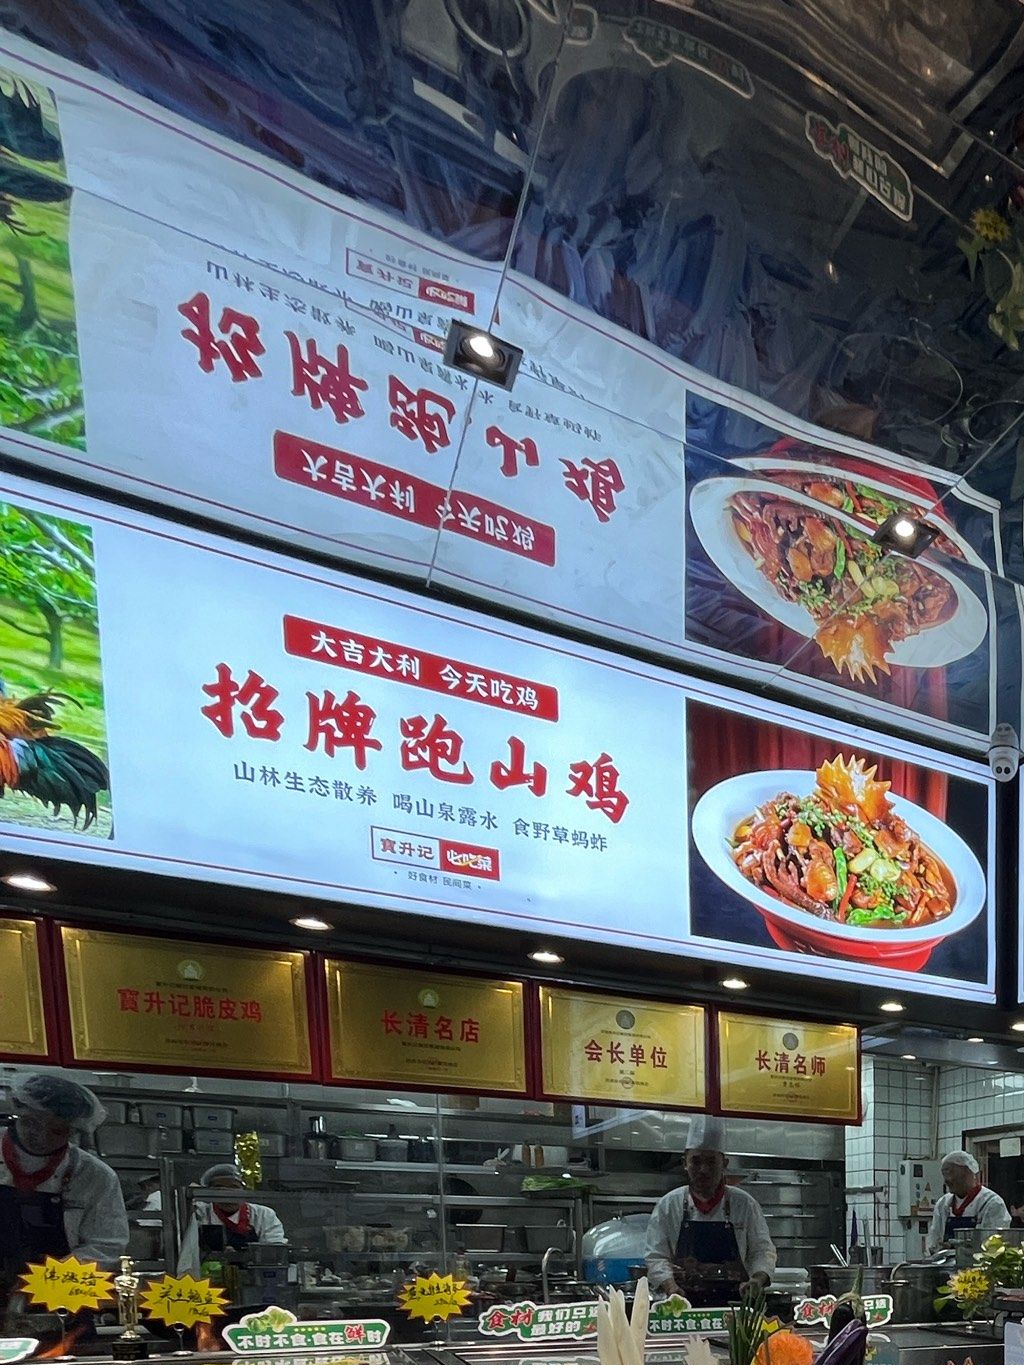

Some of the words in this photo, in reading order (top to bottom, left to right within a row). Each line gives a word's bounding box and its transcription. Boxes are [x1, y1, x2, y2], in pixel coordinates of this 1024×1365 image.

[310, 629, 421, 681] 大吉大利
[438, 663, 539, 712] 今天吃鸡
[199, 661, 631, 824] 招牌跑山鸡
[232, 759, 378, 808] 山林生态散养
[392, 791, 499, 832] 喝山泉露水
[511, 817, 608, 852] 食野草蚂蚱
[381, 1009, 481, 1044] 长清名店
[584, 1038, 669, 1070] 会长单位
[755, 1050, 827, 1078] 长清名师
[487, 1308, 534, 1329] 食材
[530, 1321, 581, 1337] 最好的
[650, 1317, 726, 1333] 不时不食·食在
